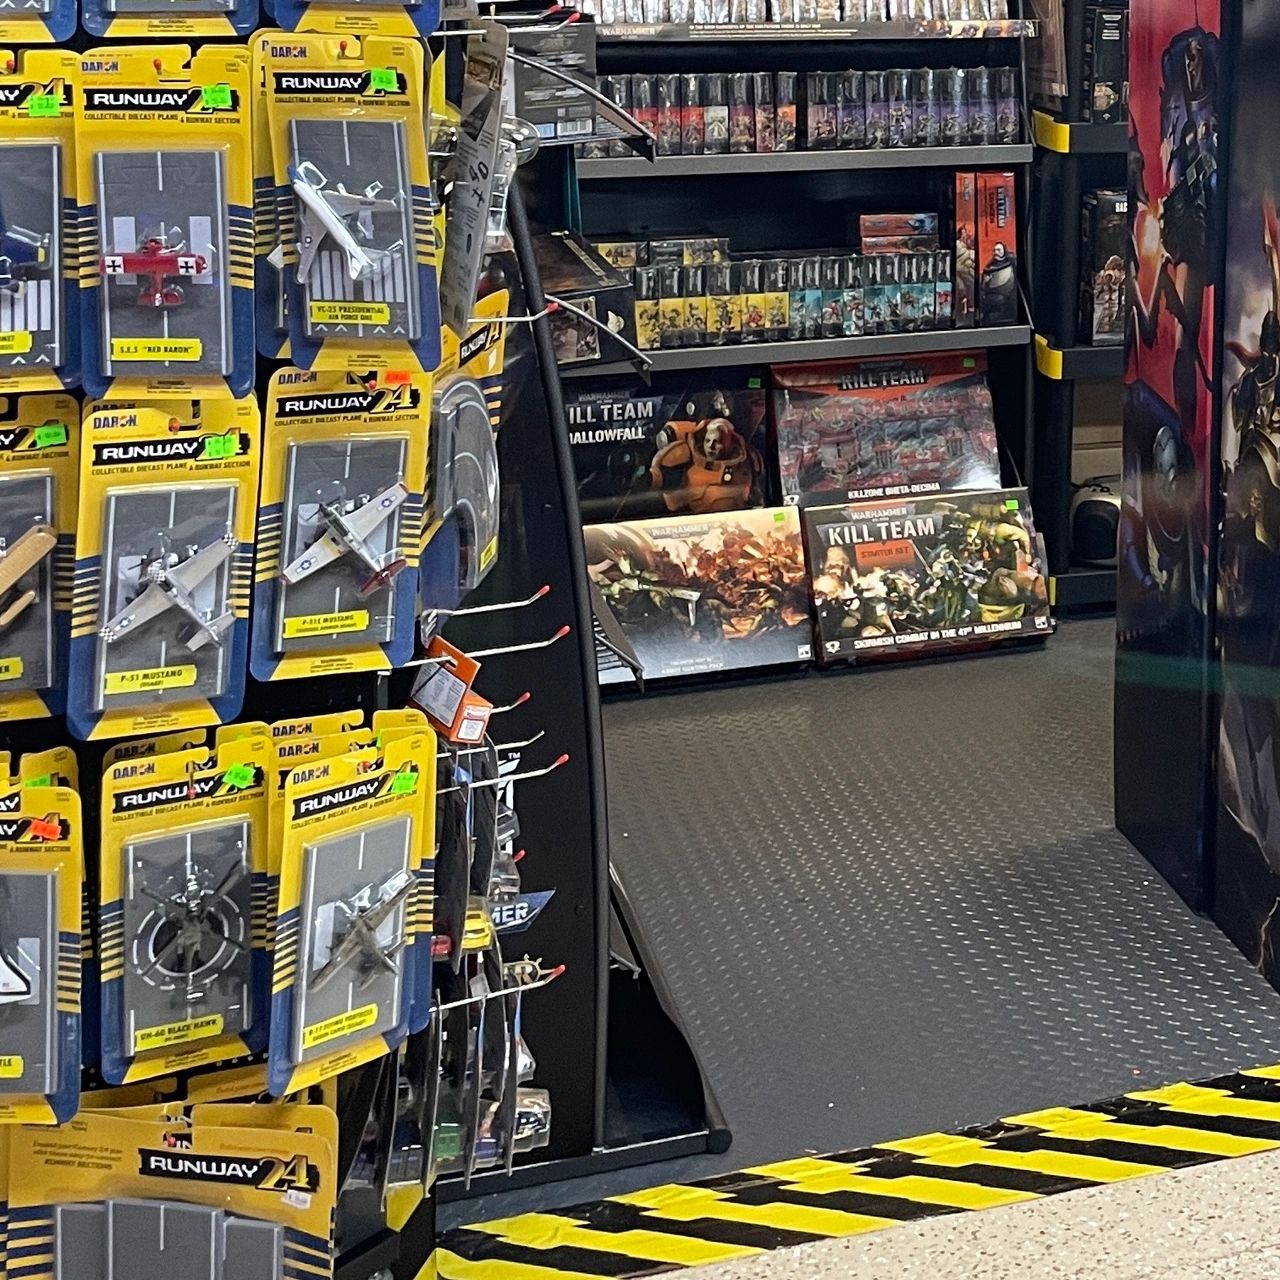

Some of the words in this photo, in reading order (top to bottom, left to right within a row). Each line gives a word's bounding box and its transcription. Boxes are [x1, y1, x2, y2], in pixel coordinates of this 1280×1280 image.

[271, 46, 307, 58] DARON
[81, 61, 119, 72] DARON
[282, 77, 362, 89] RUNWAY
[93, 93, 188, 106] RUNWAY
[338, 307, 385, 315] PRESIDENTIAL
[278, 372, 318, 384] DARON
[842, 372, 880, 390] KILL
[882, 368, 926, 387] TEAM
[285, 394, 372, 411] RUNWAY
[370, 383, 413, 414] 24
[602, 400, 654, 421] TEAM
[93, 414, 137, 429] DARON
[568, 427, 646, 445] ALLOWFALL
[102, 441, 198, 460] RUNWAY
[91, 465, 135, 475] COLLECTIBLE
[136, 463, 164, 473] DIECAST
[166, 462, 187, 471] PLANE
[847, 487, 884, 499] KILLZONE
[850, 507, 907, 520] WARHAMMER
[828, 524, 876, 546] KILL
[880, 518, 935, 541] TEAM
[853, 635, 894, 650] SKIRMISH
[895, 631, 929, 646] COMBAT
[930, 631, 939, 642] IN
[941, 629, 956, 641] THE
[973, 621, 1023, 638] MILLENNIUM
[120, 673, 138, 683] P-51
[141, 669, 183, 681] MUSTANG
[273, 723, 312, 737] DARON
[278, 742, 319, 758] DARON
[113, 762, 155, 780] DARON
[293, 765, 330, 785] DARON
[122, 779, 216, 807] RUNWAY
[300, 781, 379, 813] RUNWAY
[167, 1024, 191, 1035] BLACK
[193, 1018, 219, 1031] HAWK
[150, 1156, 258, 1179] RUNWAY
[255, 1154, 312, 1191] 24
